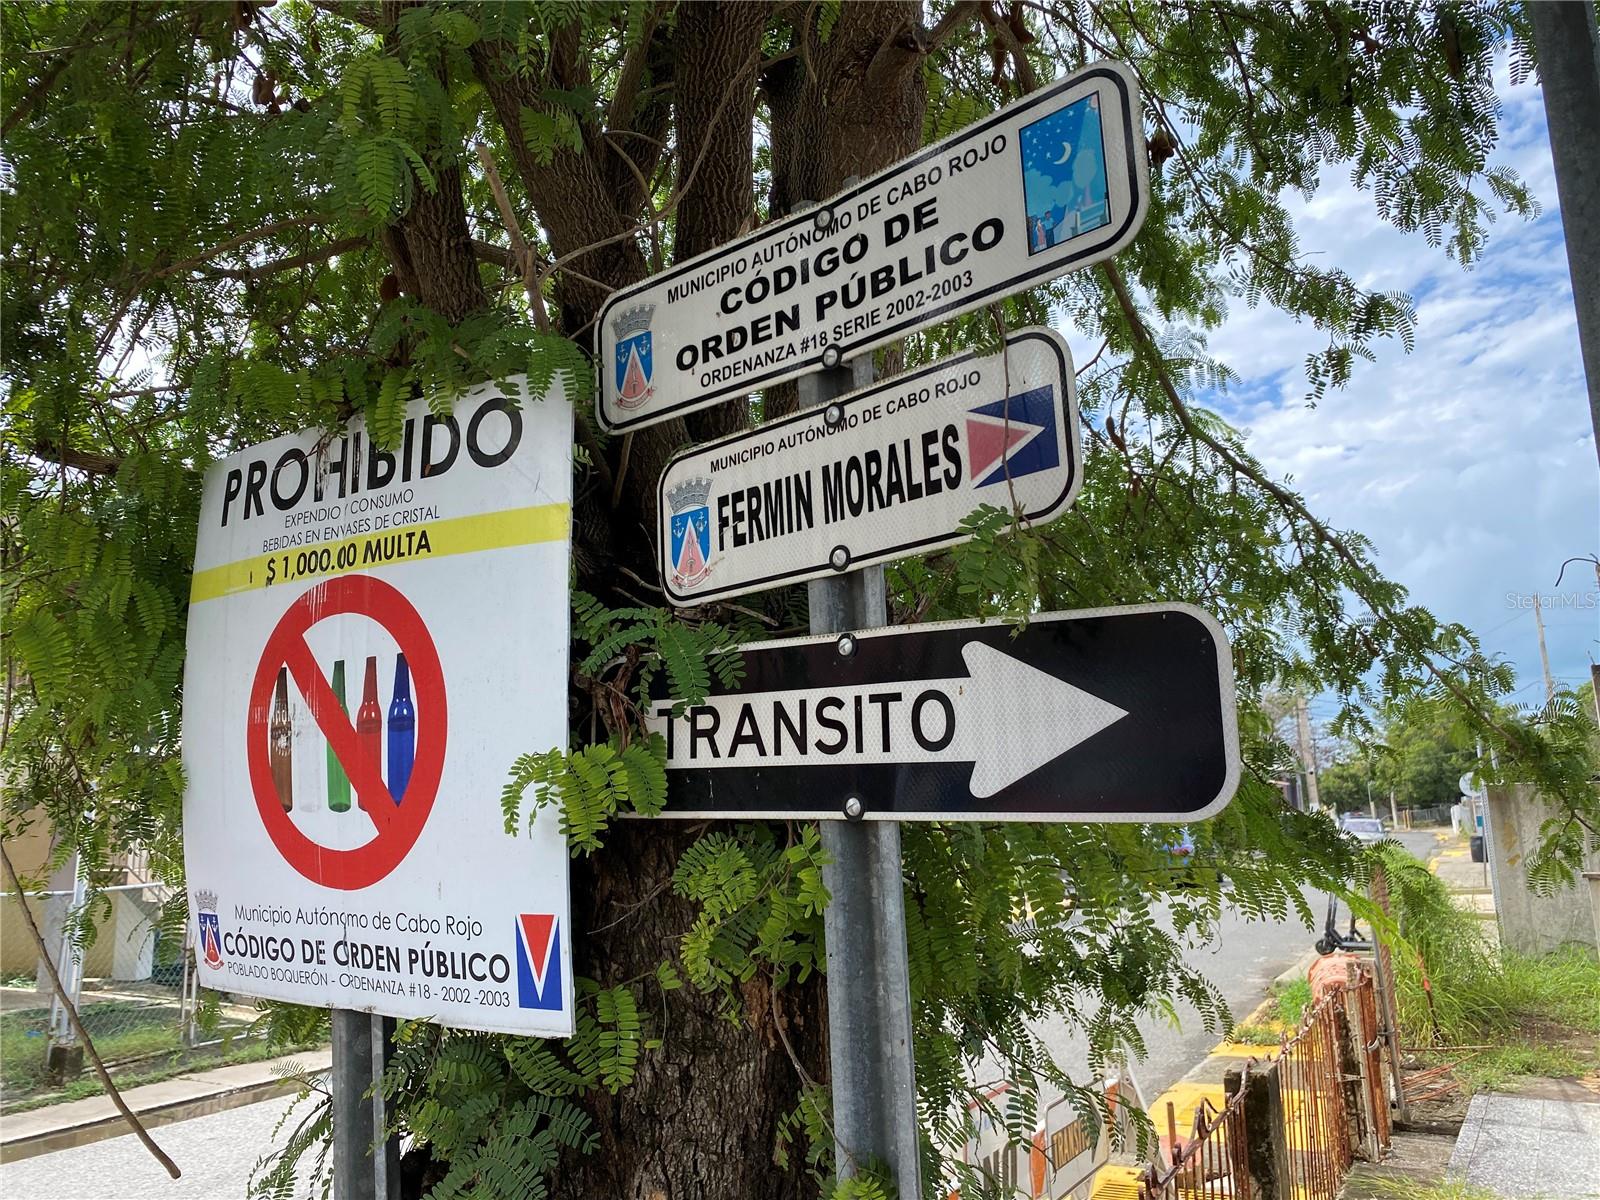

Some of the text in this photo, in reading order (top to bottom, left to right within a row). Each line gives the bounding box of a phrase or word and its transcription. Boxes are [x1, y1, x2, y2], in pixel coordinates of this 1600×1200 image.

[667, 134, 1006, 304] MUNICIPIO AUTÓNOMO DE CABO ROJO
[720, 197, 938, 315] CÓDIGO DE
[676, 217, 1004, 371] ORDEN PÚBLICO
[701, 270, 973, 387] ORDENANZA #18 SERIE 2002-2003
[710, 441, 774, 474] MUNICIPIO
[863, 404, 882, 424] DE
[887, 388, 930, 415] CABO
[935, 370, 981, 399] ROJO
[284, 505, 341, 528] EXPENDIO
[350, 488, 414, 515] CONSUMO
[717, 423, 963, 551] FERMIN MORALES
[263, 505, 440, 553] BEBIDAS EN ENVASES DE CRISTAL
[362, 530, 432, 564] MULTA
[656, 689, 956, 760] TRANSITO
[223, 926, 510, 983] CÓDIGO DE ORDEN PÚBLICO
[235, 904, 483, 941] Municipio Autónomo de Cabo Rojo
[227, 961, 268, 980] POBLADO
[271, 968, 328, 986] BOQUERÓN
[339, 973, 405, 997] ORDENANZA
[409, 983, 431, 999] #18
